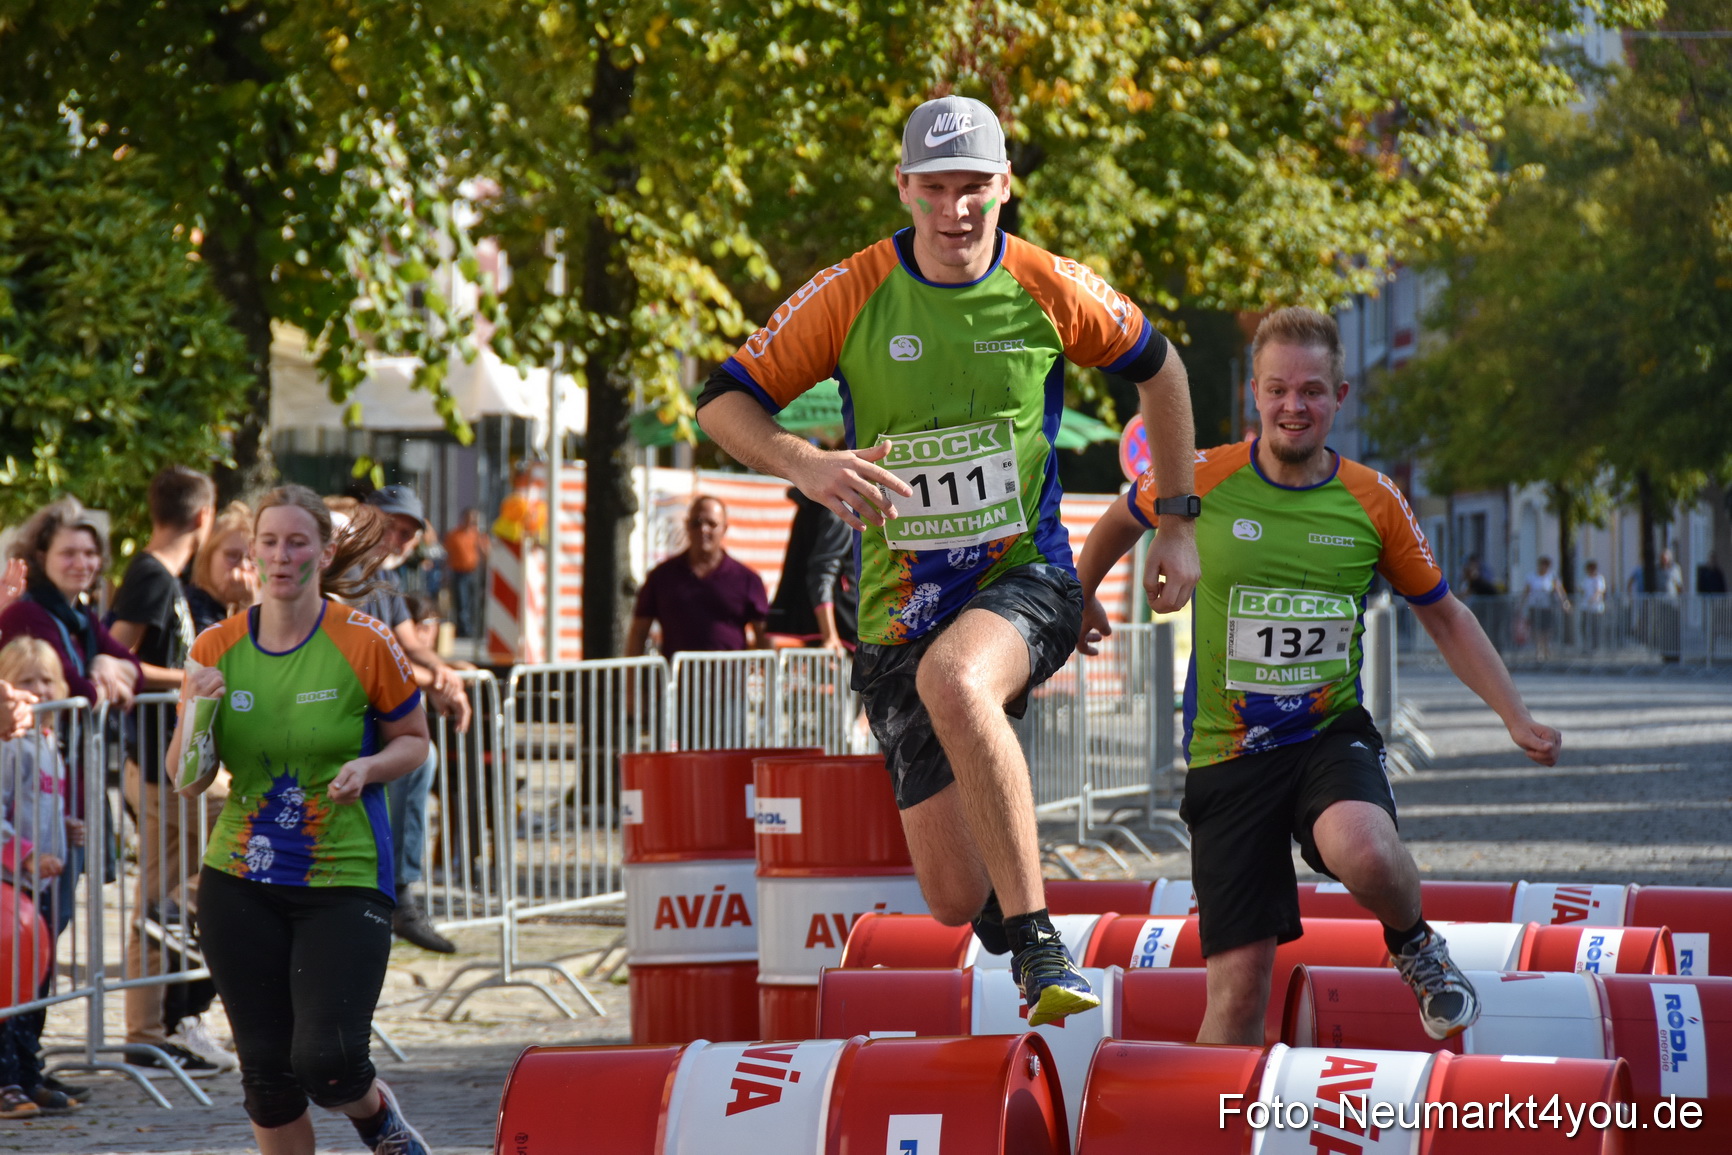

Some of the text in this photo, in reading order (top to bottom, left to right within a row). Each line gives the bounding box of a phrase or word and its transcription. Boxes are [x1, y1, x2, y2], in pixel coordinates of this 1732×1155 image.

[933, 113, 972, 132] NIKE
[745, 263, 849, 358] BOCK
[974, 339, 1026, 353] BOCK
[882, 424, 1002, 465] BOCK
[909, 466, 987, 507] 111
[899, 506, 1007, 537] JONATHAN
[1309, 533, 1355, 547] BOCK
[1238, 590, 1346, 618] BOCK
[1257, 627, 1326, 658] 132
[1256, 667, 1321, 682] DANIEL
[296, 689, 338, 704] BOCK
[1660, 1029, 1670, 1072] energie
